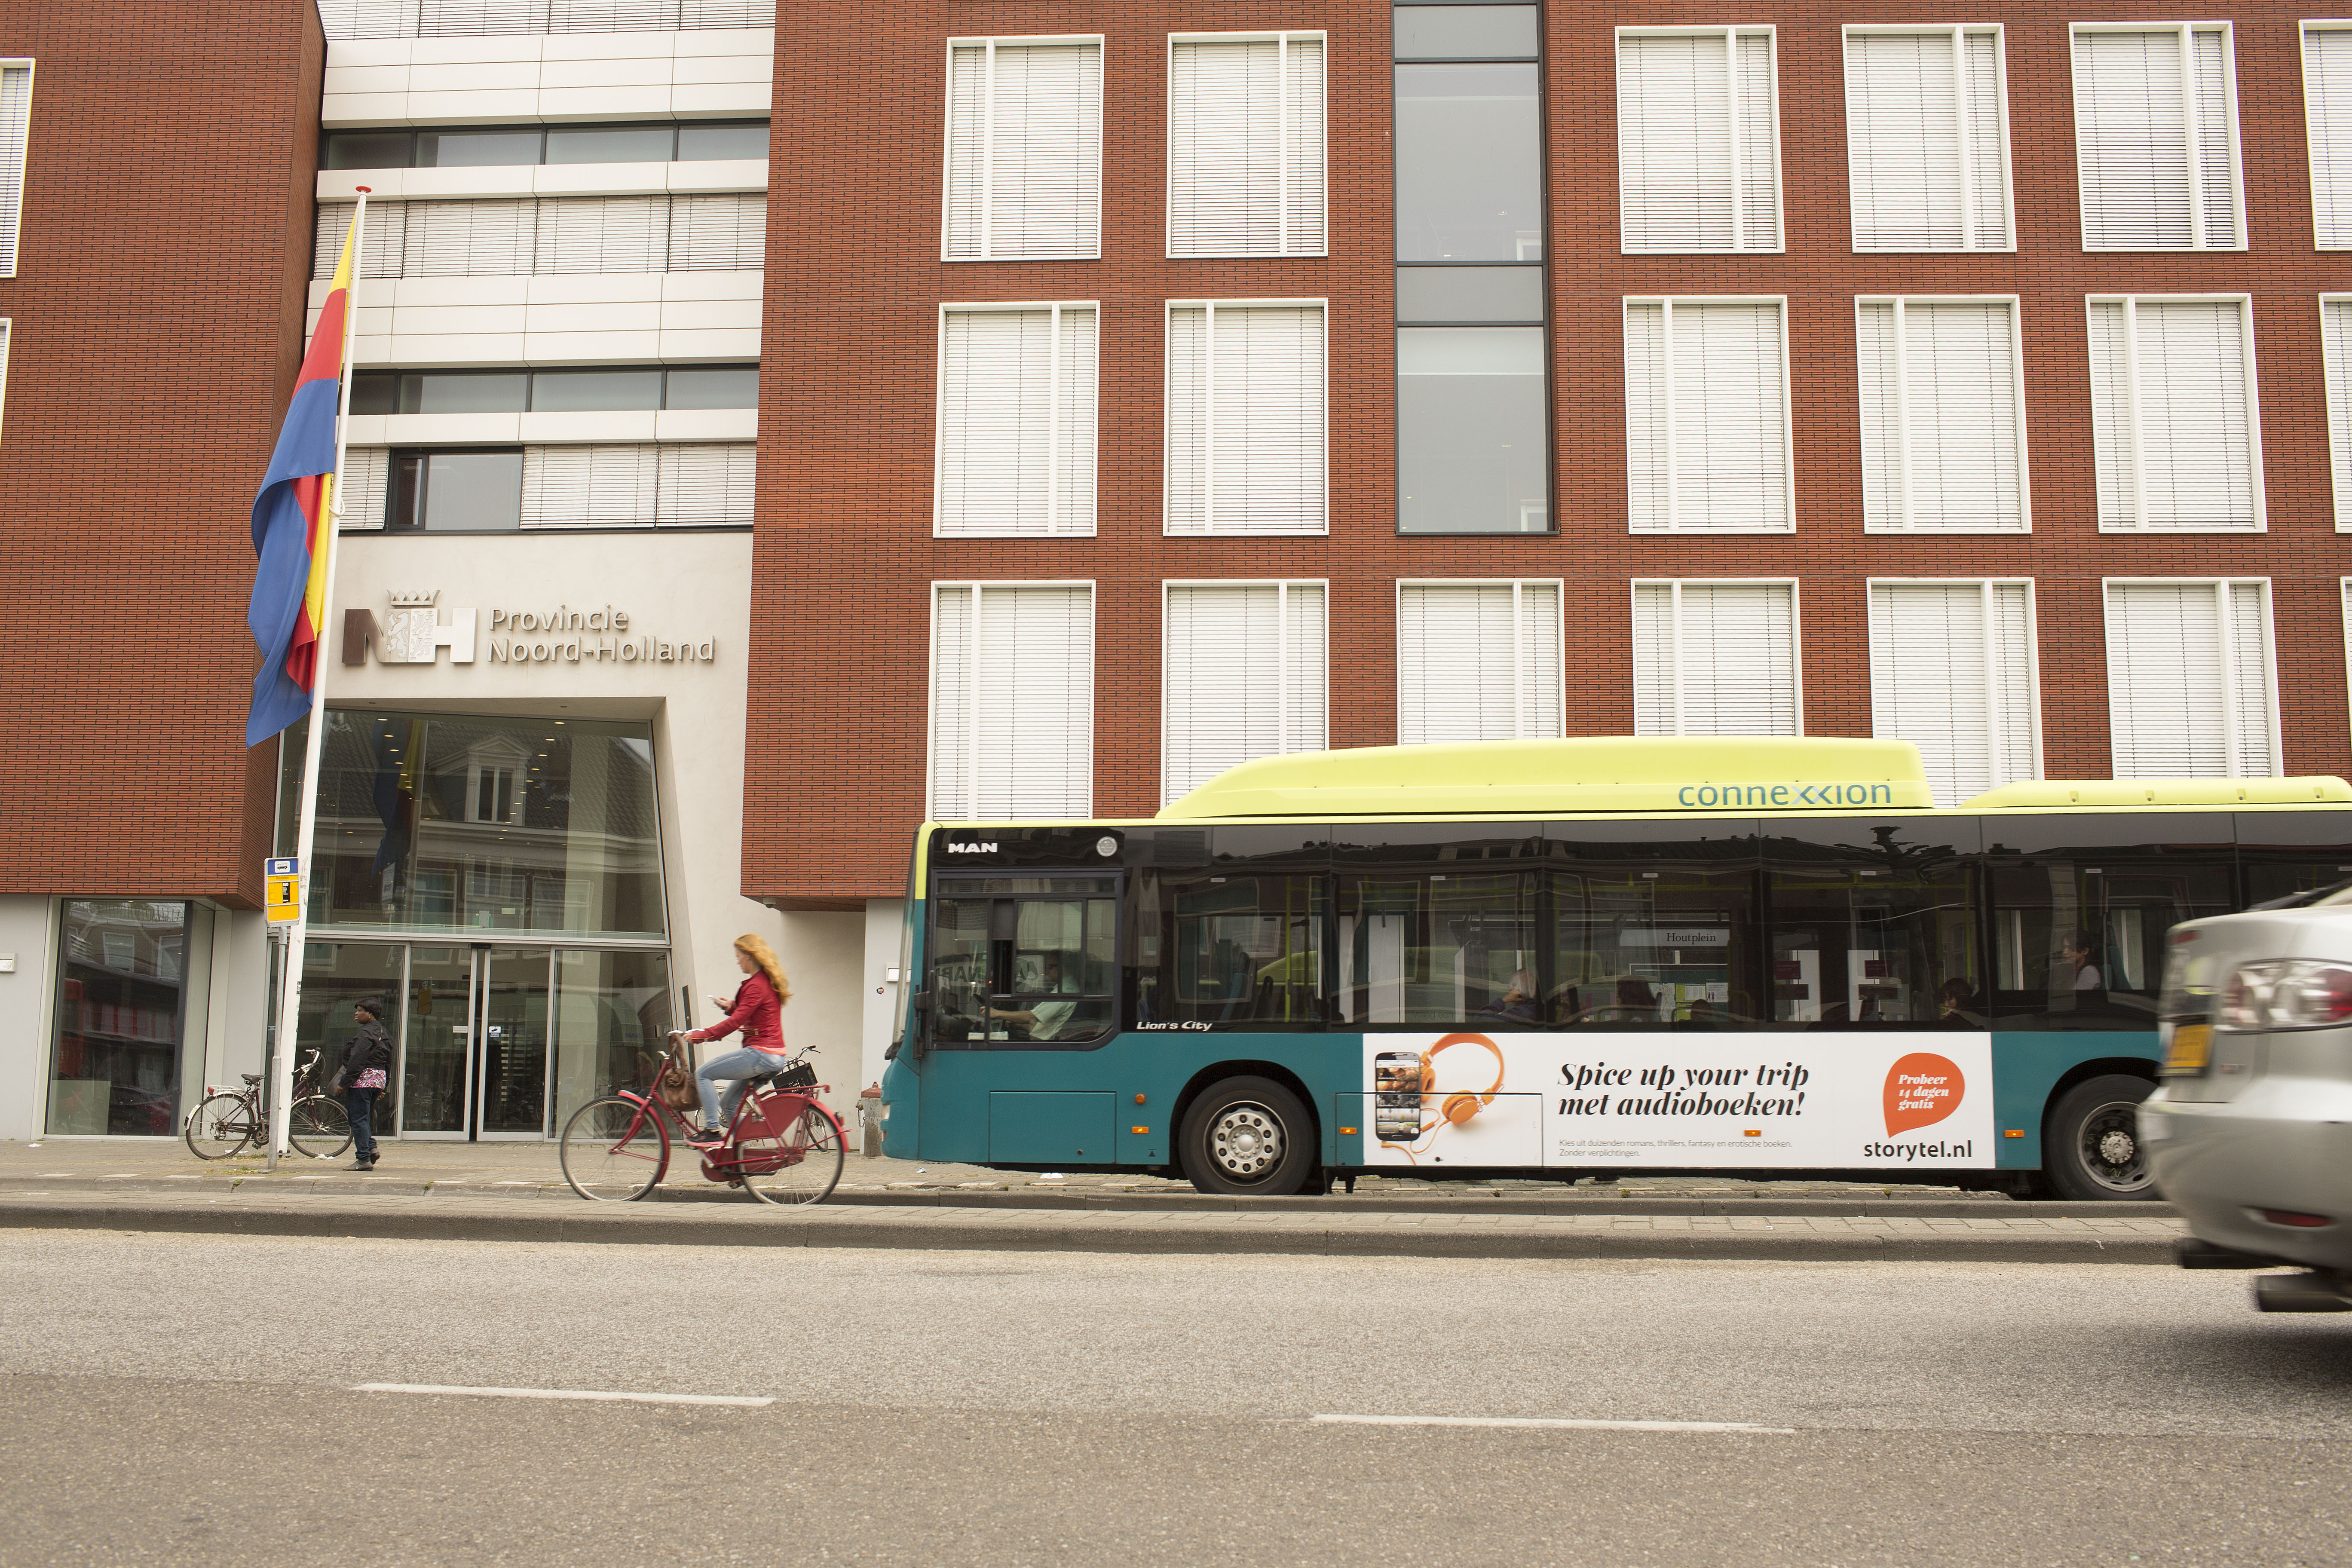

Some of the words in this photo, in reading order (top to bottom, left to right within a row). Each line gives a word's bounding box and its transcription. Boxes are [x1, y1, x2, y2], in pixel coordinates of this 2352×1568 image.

[489, 603, 629, 632] Provincie
[487, 635, 715, 662] Noord-Holland
[1678, 784, 1892, 807] connexxion
[948, 842, 998, 853] MAN
[1666, 932, 1716, 945] Houtplein
[1136, 1021, 1179, 1029] Lion's
[1181, 1021, 1213, 1032] City
[1557, 1062, 1632, 1090] Spice
[1641, 1065, 1675, 1090] up
[1680, 1069, 1748, 1090] your
[1758, 1062, 1809, 1091] trip
[1898, 1074, 1948, 1084] Probeer
[1899, 1089, 1911, 1098] 14
[1913, 1086, 1949, 1099] dagen
[1558, 1094, 1611, 1115] met
[1617, 1091, 1805, 1116] audioboeken!
[1897, 1098, 1934, 1111] gratis
[1587, 1149, 1641, 1158] verplichtingen.
[1864, 1140, 1972, 1162] storytel.nl
